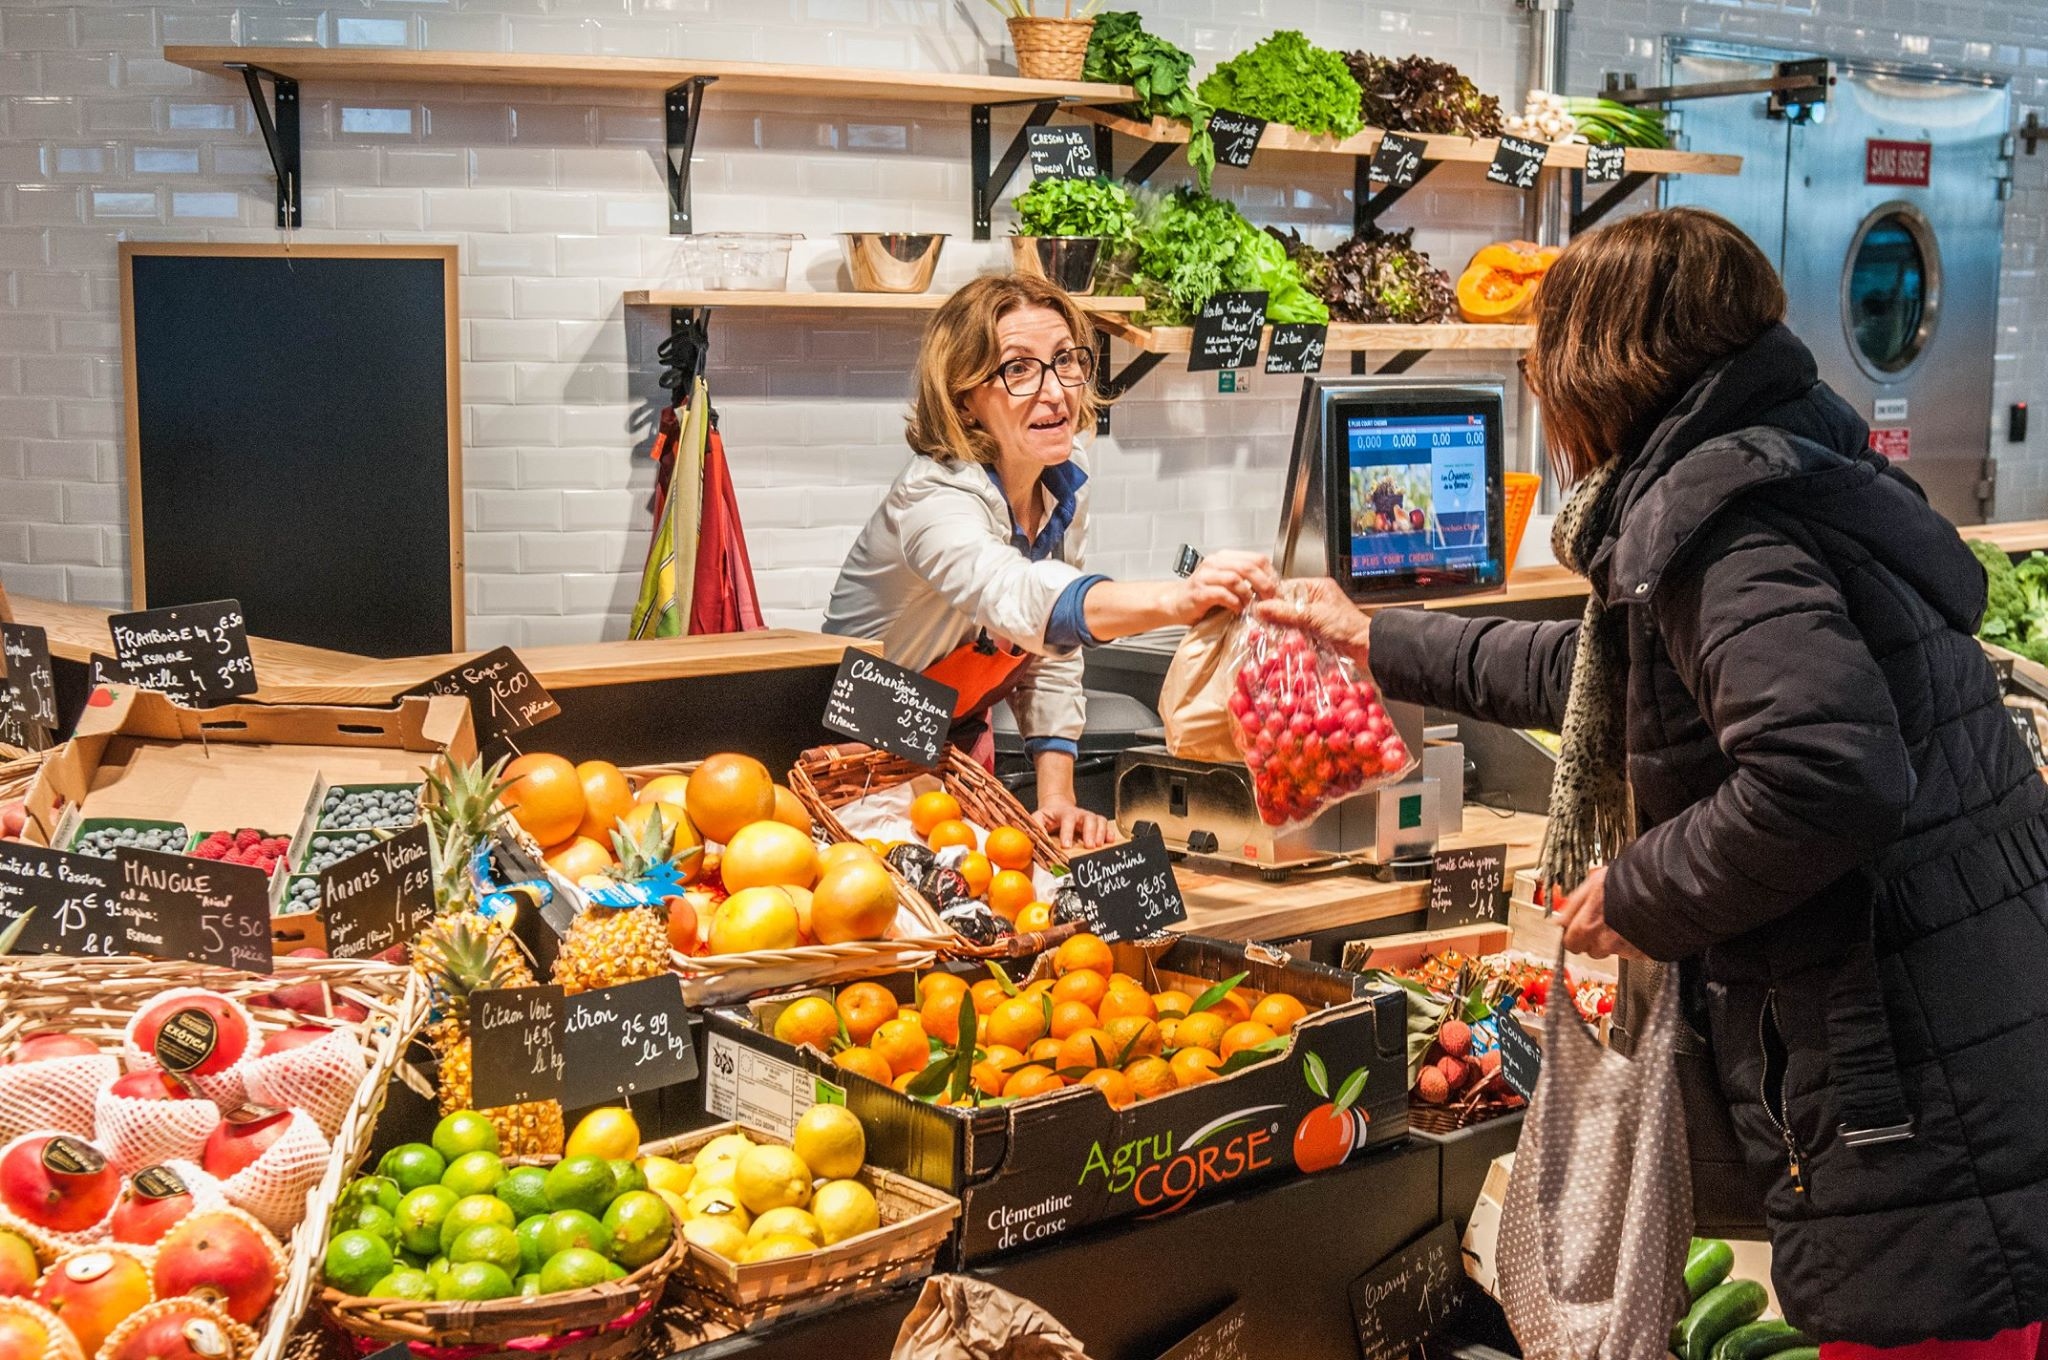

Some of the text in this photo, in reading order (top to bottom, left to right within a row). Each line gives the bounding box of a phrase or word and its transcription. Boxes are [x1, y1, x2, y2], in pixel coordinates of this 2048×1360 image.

[1871, 147, 1926, 179] SANS ISSUE
[124, 859, 212, 893] MANGUE
[529, 997, 552, 1021] Vert
[1077, 1129, 1173, 1194] Agru
[1133, 1127, 1273, 1207] CORSE
[987, 1193, 1073, 1231] Clémentine
[997, 1217, 1067, 1250] de Corse
